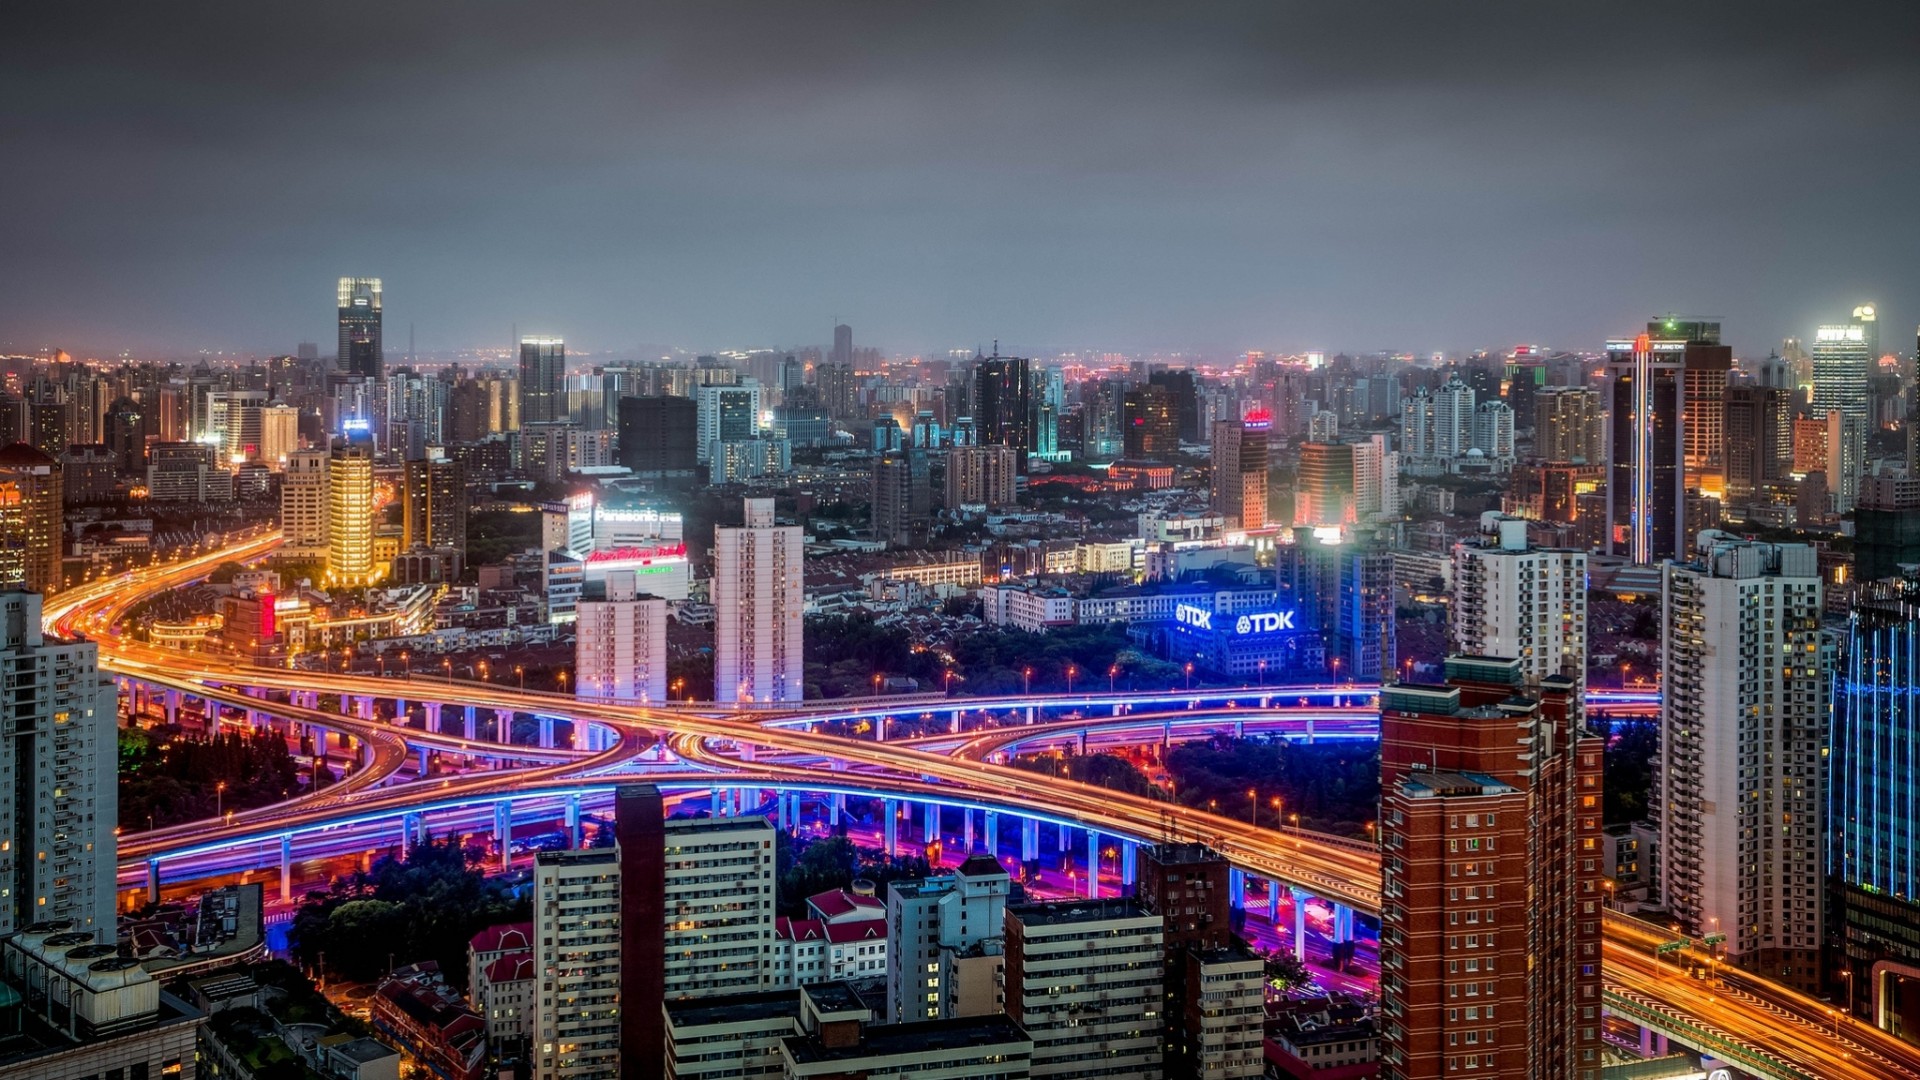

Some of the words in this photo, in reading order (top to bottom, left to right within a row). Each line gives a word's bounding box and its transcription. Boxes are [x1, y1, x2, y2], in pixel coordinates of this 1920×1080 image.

[595, 506, 658, 521] Panasonic
[1183, 604, 1212, 630] TDK
[1249, 610, 1295, 633] TDK
